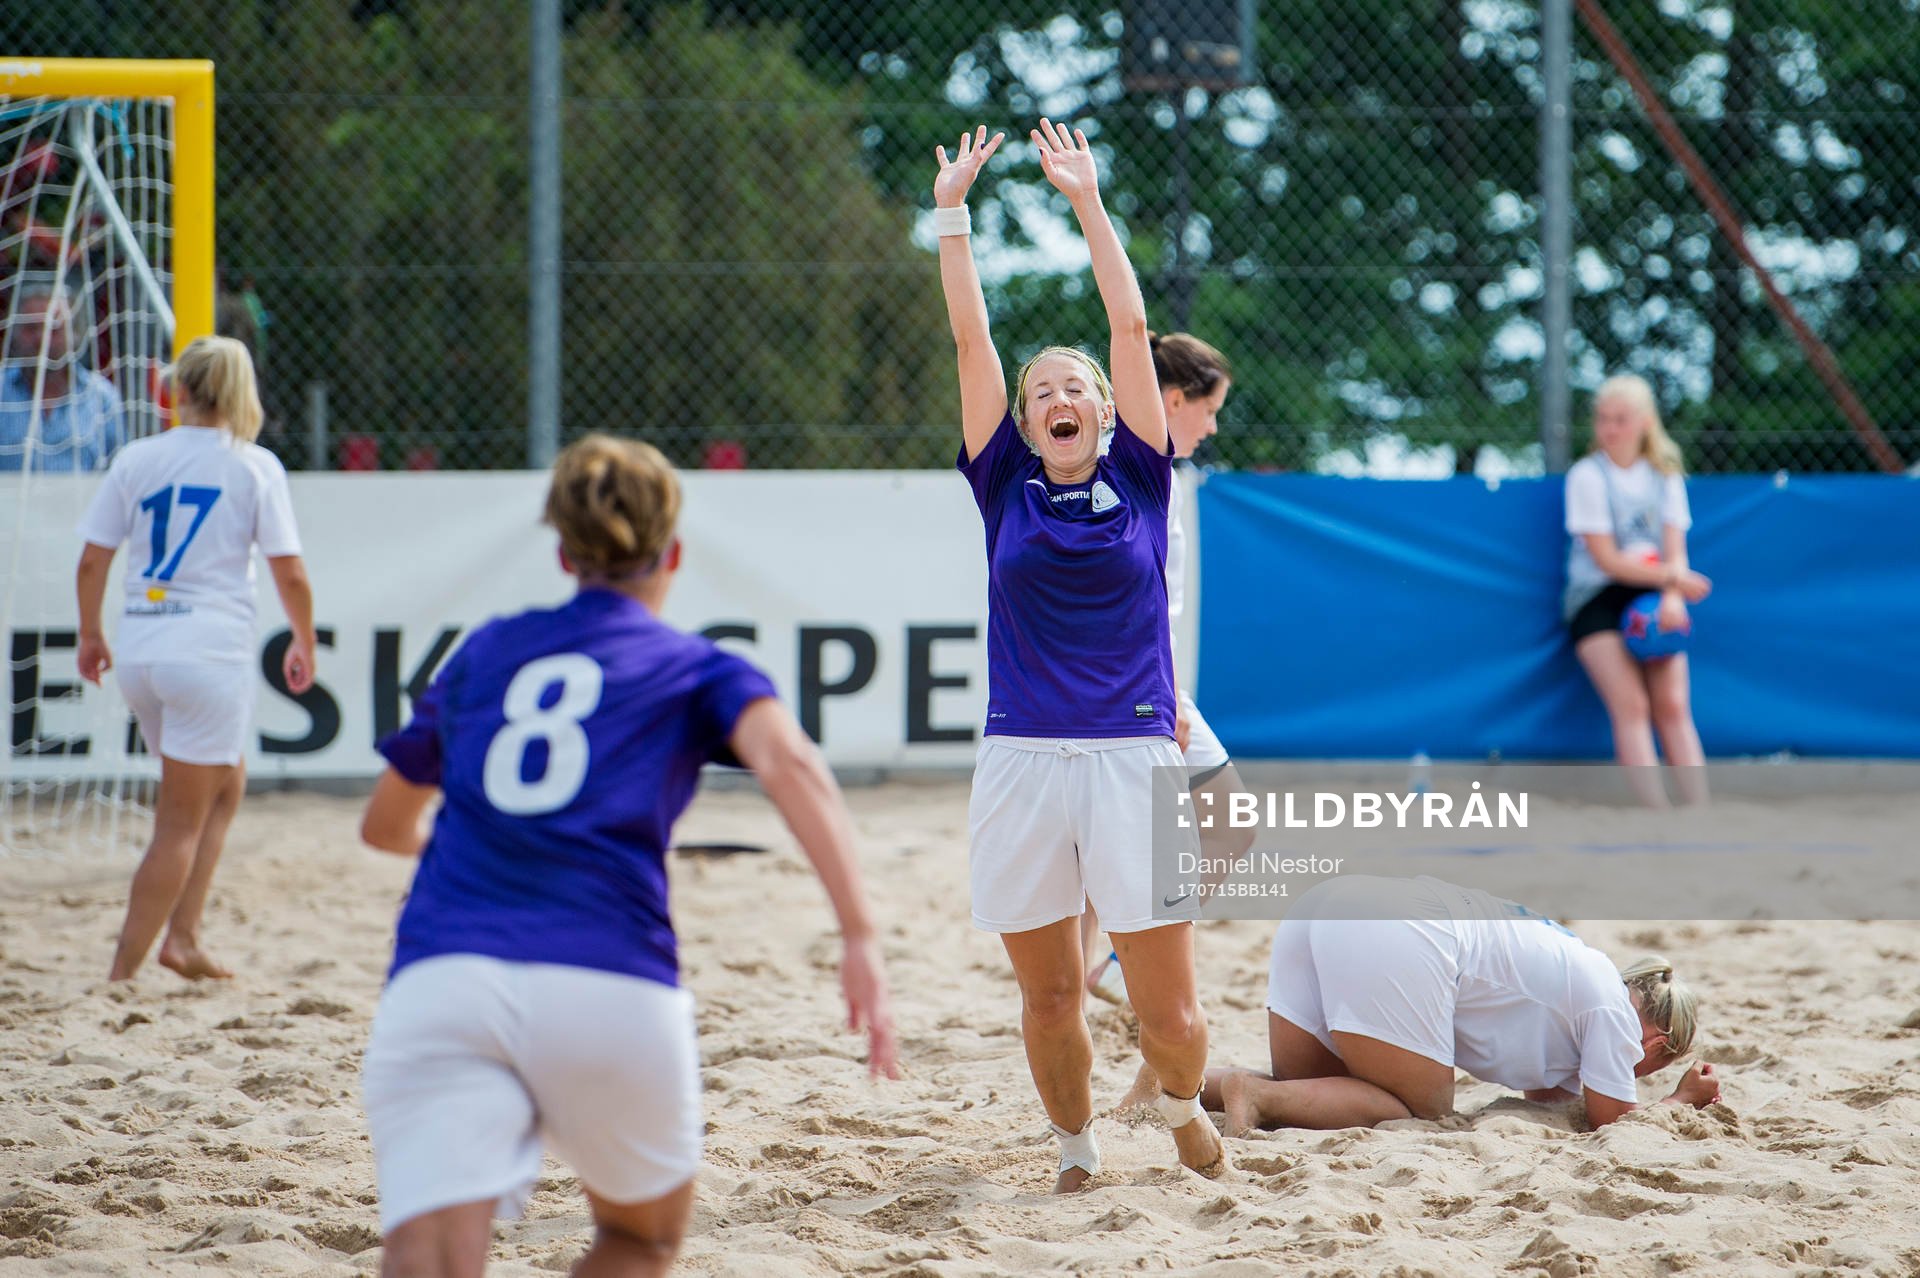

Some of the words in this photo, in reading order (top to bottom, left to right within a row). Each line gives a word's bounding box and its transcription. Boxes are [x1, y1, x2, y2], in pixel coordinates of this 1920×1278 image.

[141, 485, 222, 581] 17
[11, 628, 464, 755] ESK
[483, 652, 604, 816] 8
